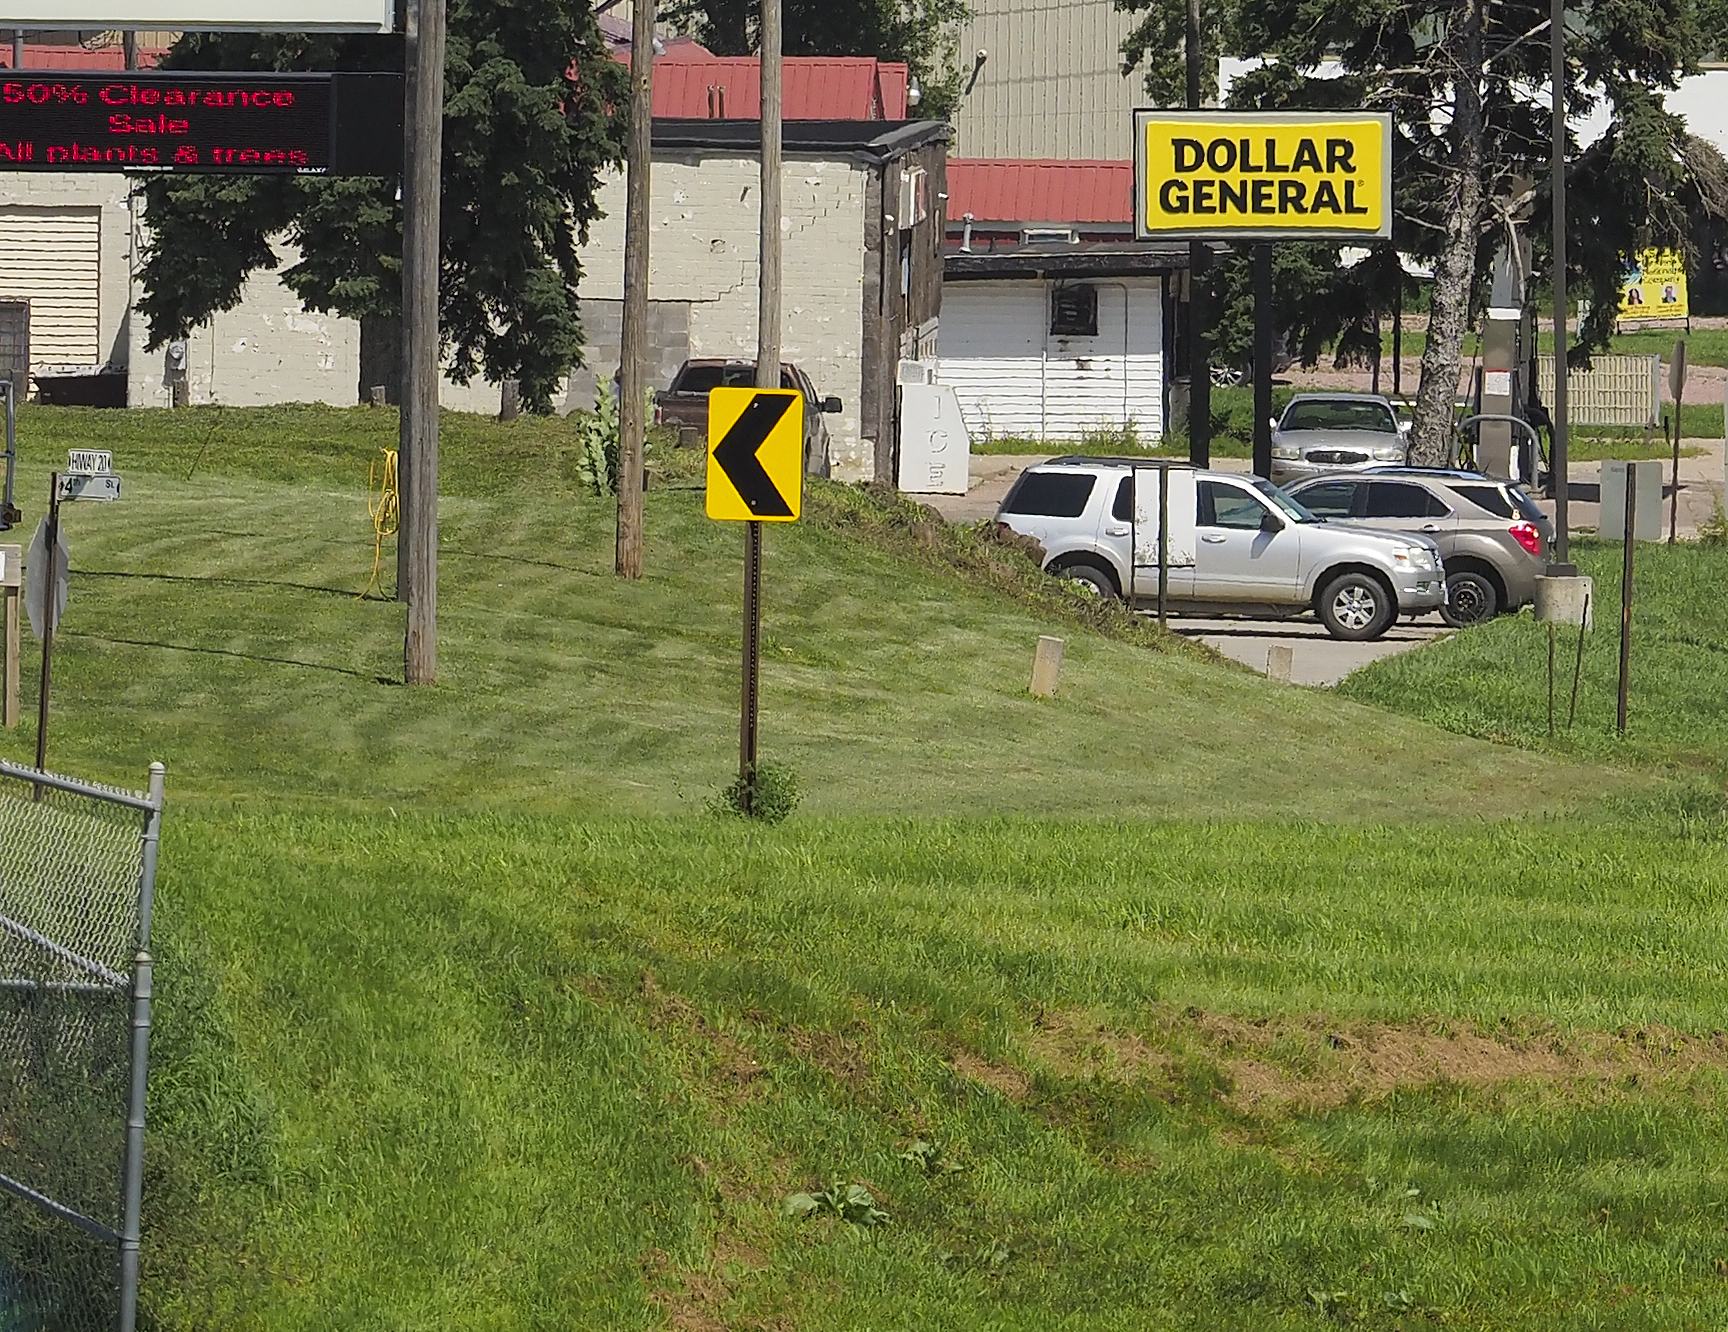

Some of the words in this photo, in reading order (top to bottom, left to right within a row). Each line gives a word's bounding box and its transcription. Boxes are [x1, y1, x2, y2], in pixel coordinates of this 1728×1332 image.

[3, 83, 88, 105] 50%
[100, 83, 295, 106] Clearance
[108, 113, 189, 134] Sale
[46, 142, 159, 164] plants
[173, 144, 198, 164] &
[212, 146, 308, 166] trees
[1171, 138, 1357, 174] DOLLAR
[1159, 179, 1369, 215] GENERAL
